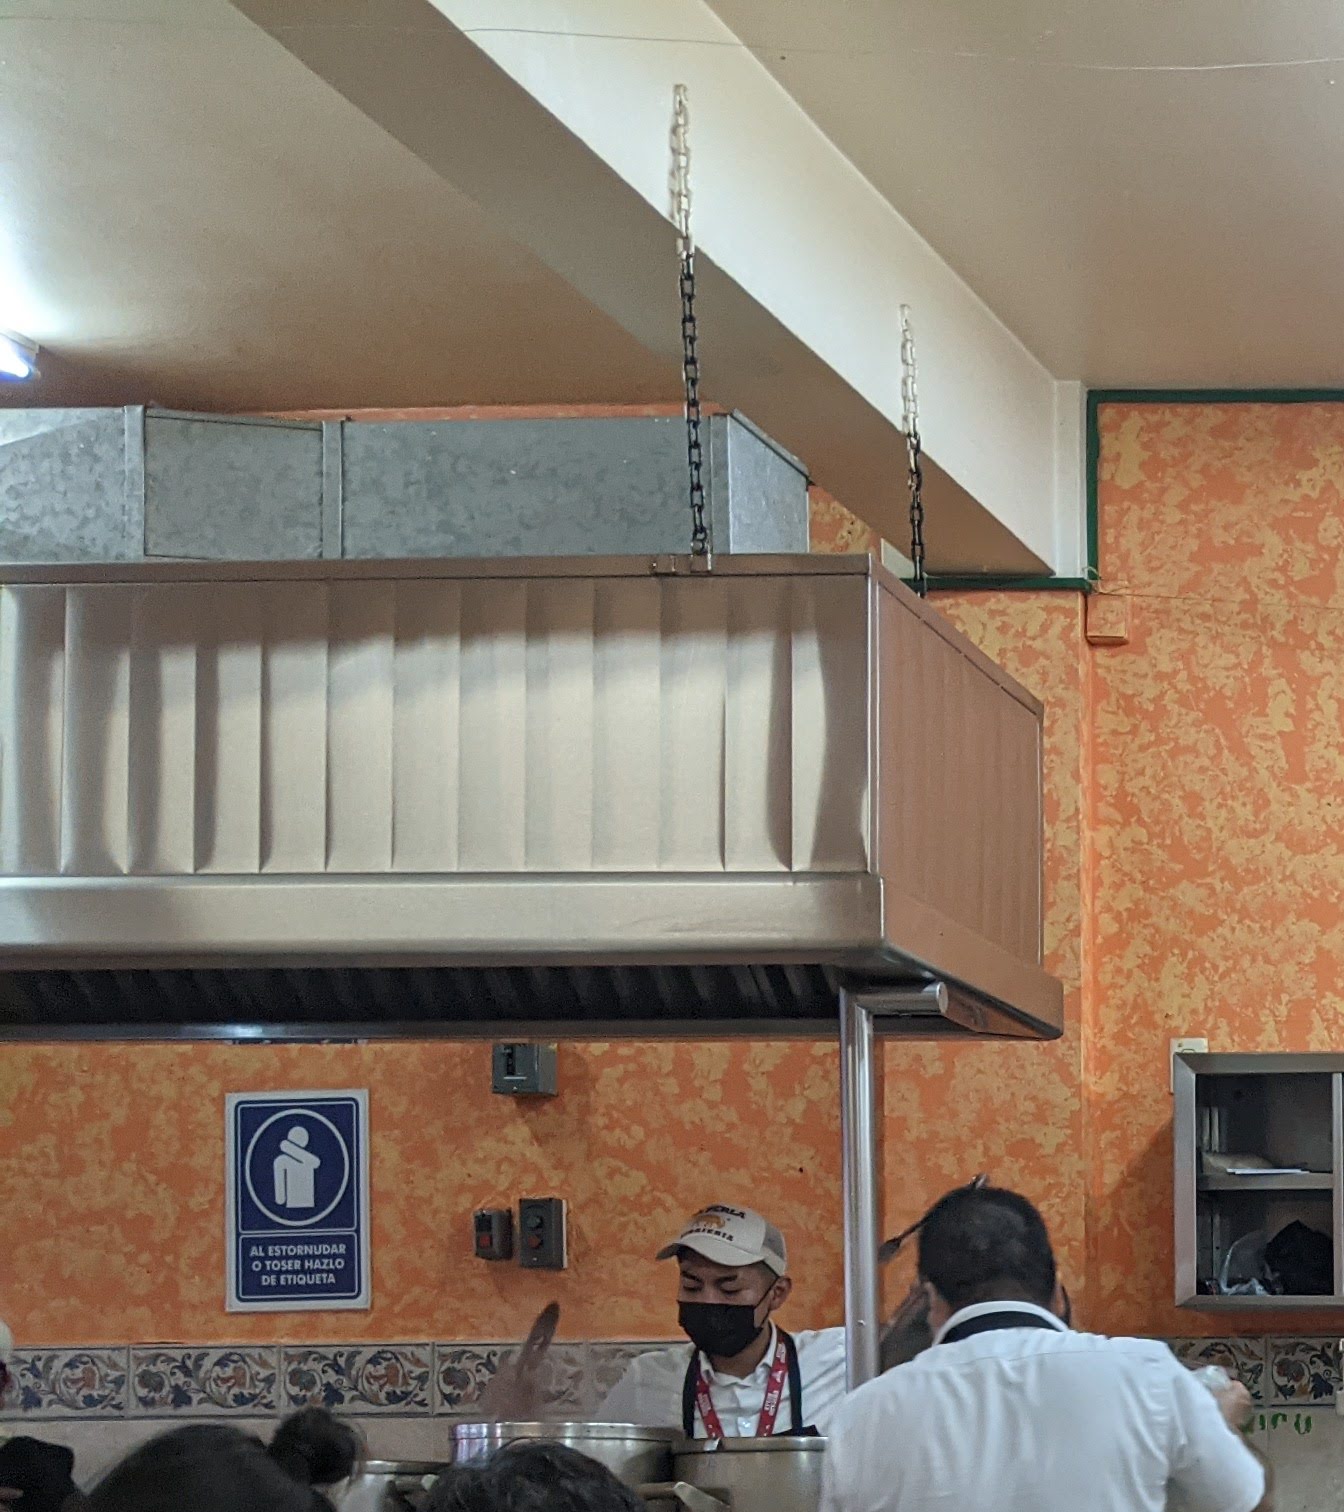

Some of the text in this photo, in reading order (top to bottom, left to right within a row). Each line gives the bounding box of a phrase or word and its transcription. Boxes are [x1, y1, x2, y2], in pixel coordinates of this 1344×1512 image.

[250, 1244, 346, 1257] AL ESTORNUDAR
[252, 1258, 345, 1271] O TOSER HAZLO
[261, 1273, 336, 1286] DE ETIQUETA
